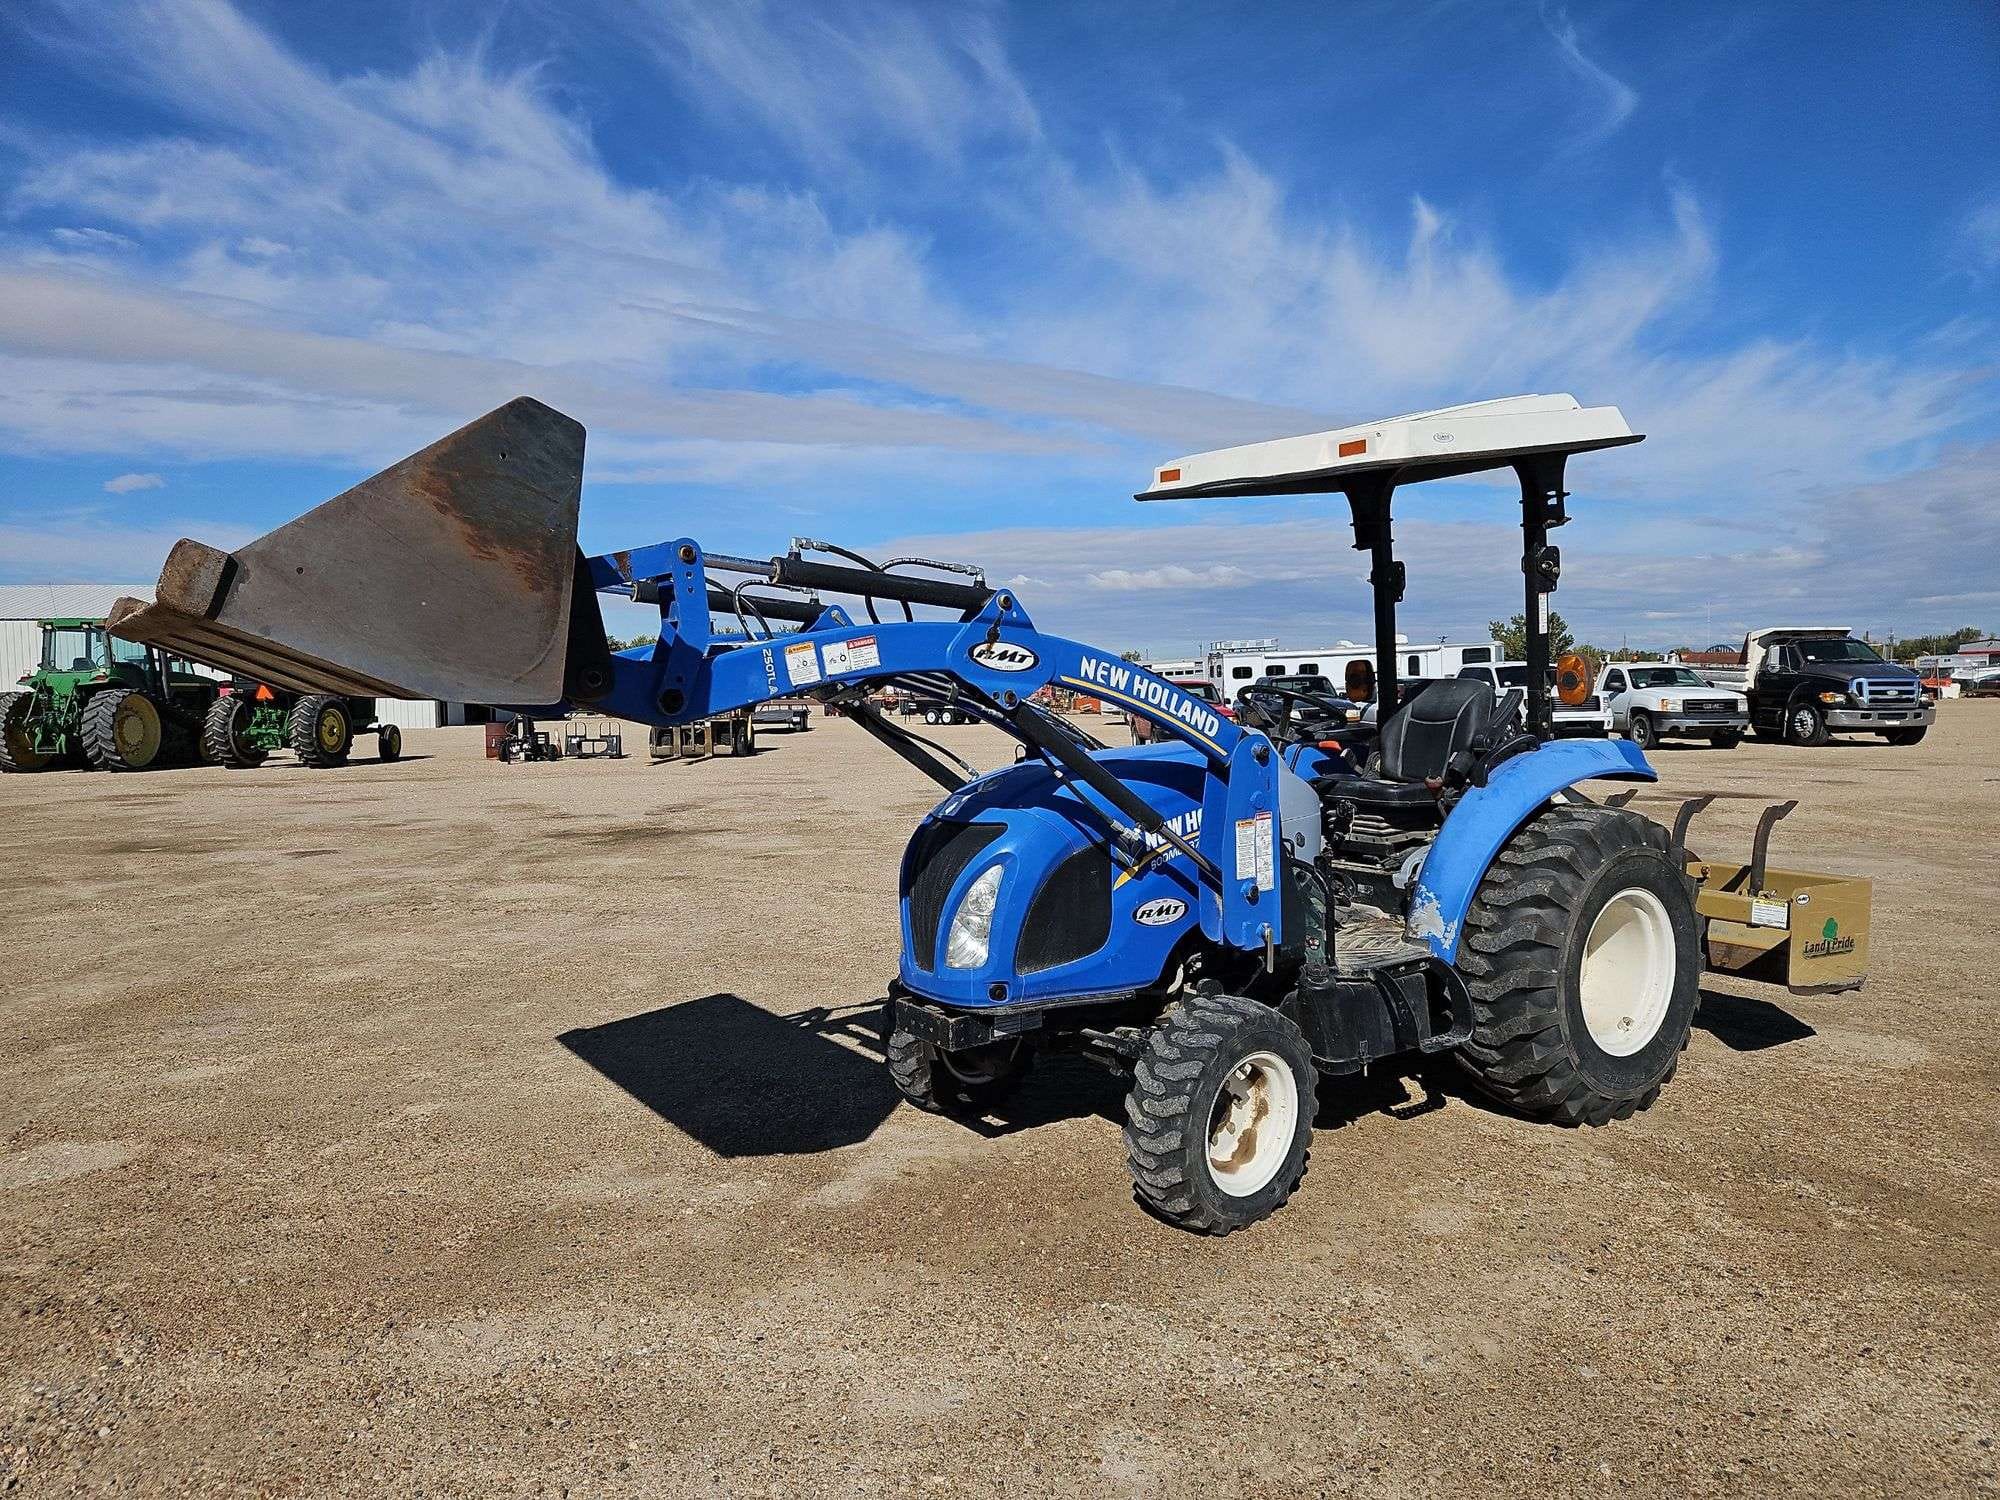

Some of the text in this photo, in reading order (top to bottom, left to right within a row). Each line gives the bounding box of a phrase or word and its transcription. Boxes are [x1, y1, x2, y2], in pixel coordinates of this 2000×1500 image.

[762, 648, 779, 695] 250TLA
[1080, 655, 1219, 737] NEW HOLLAND
[1138, 903, 1184, 920] RMT
[1804, 936, 1855, 954] Land Pride
